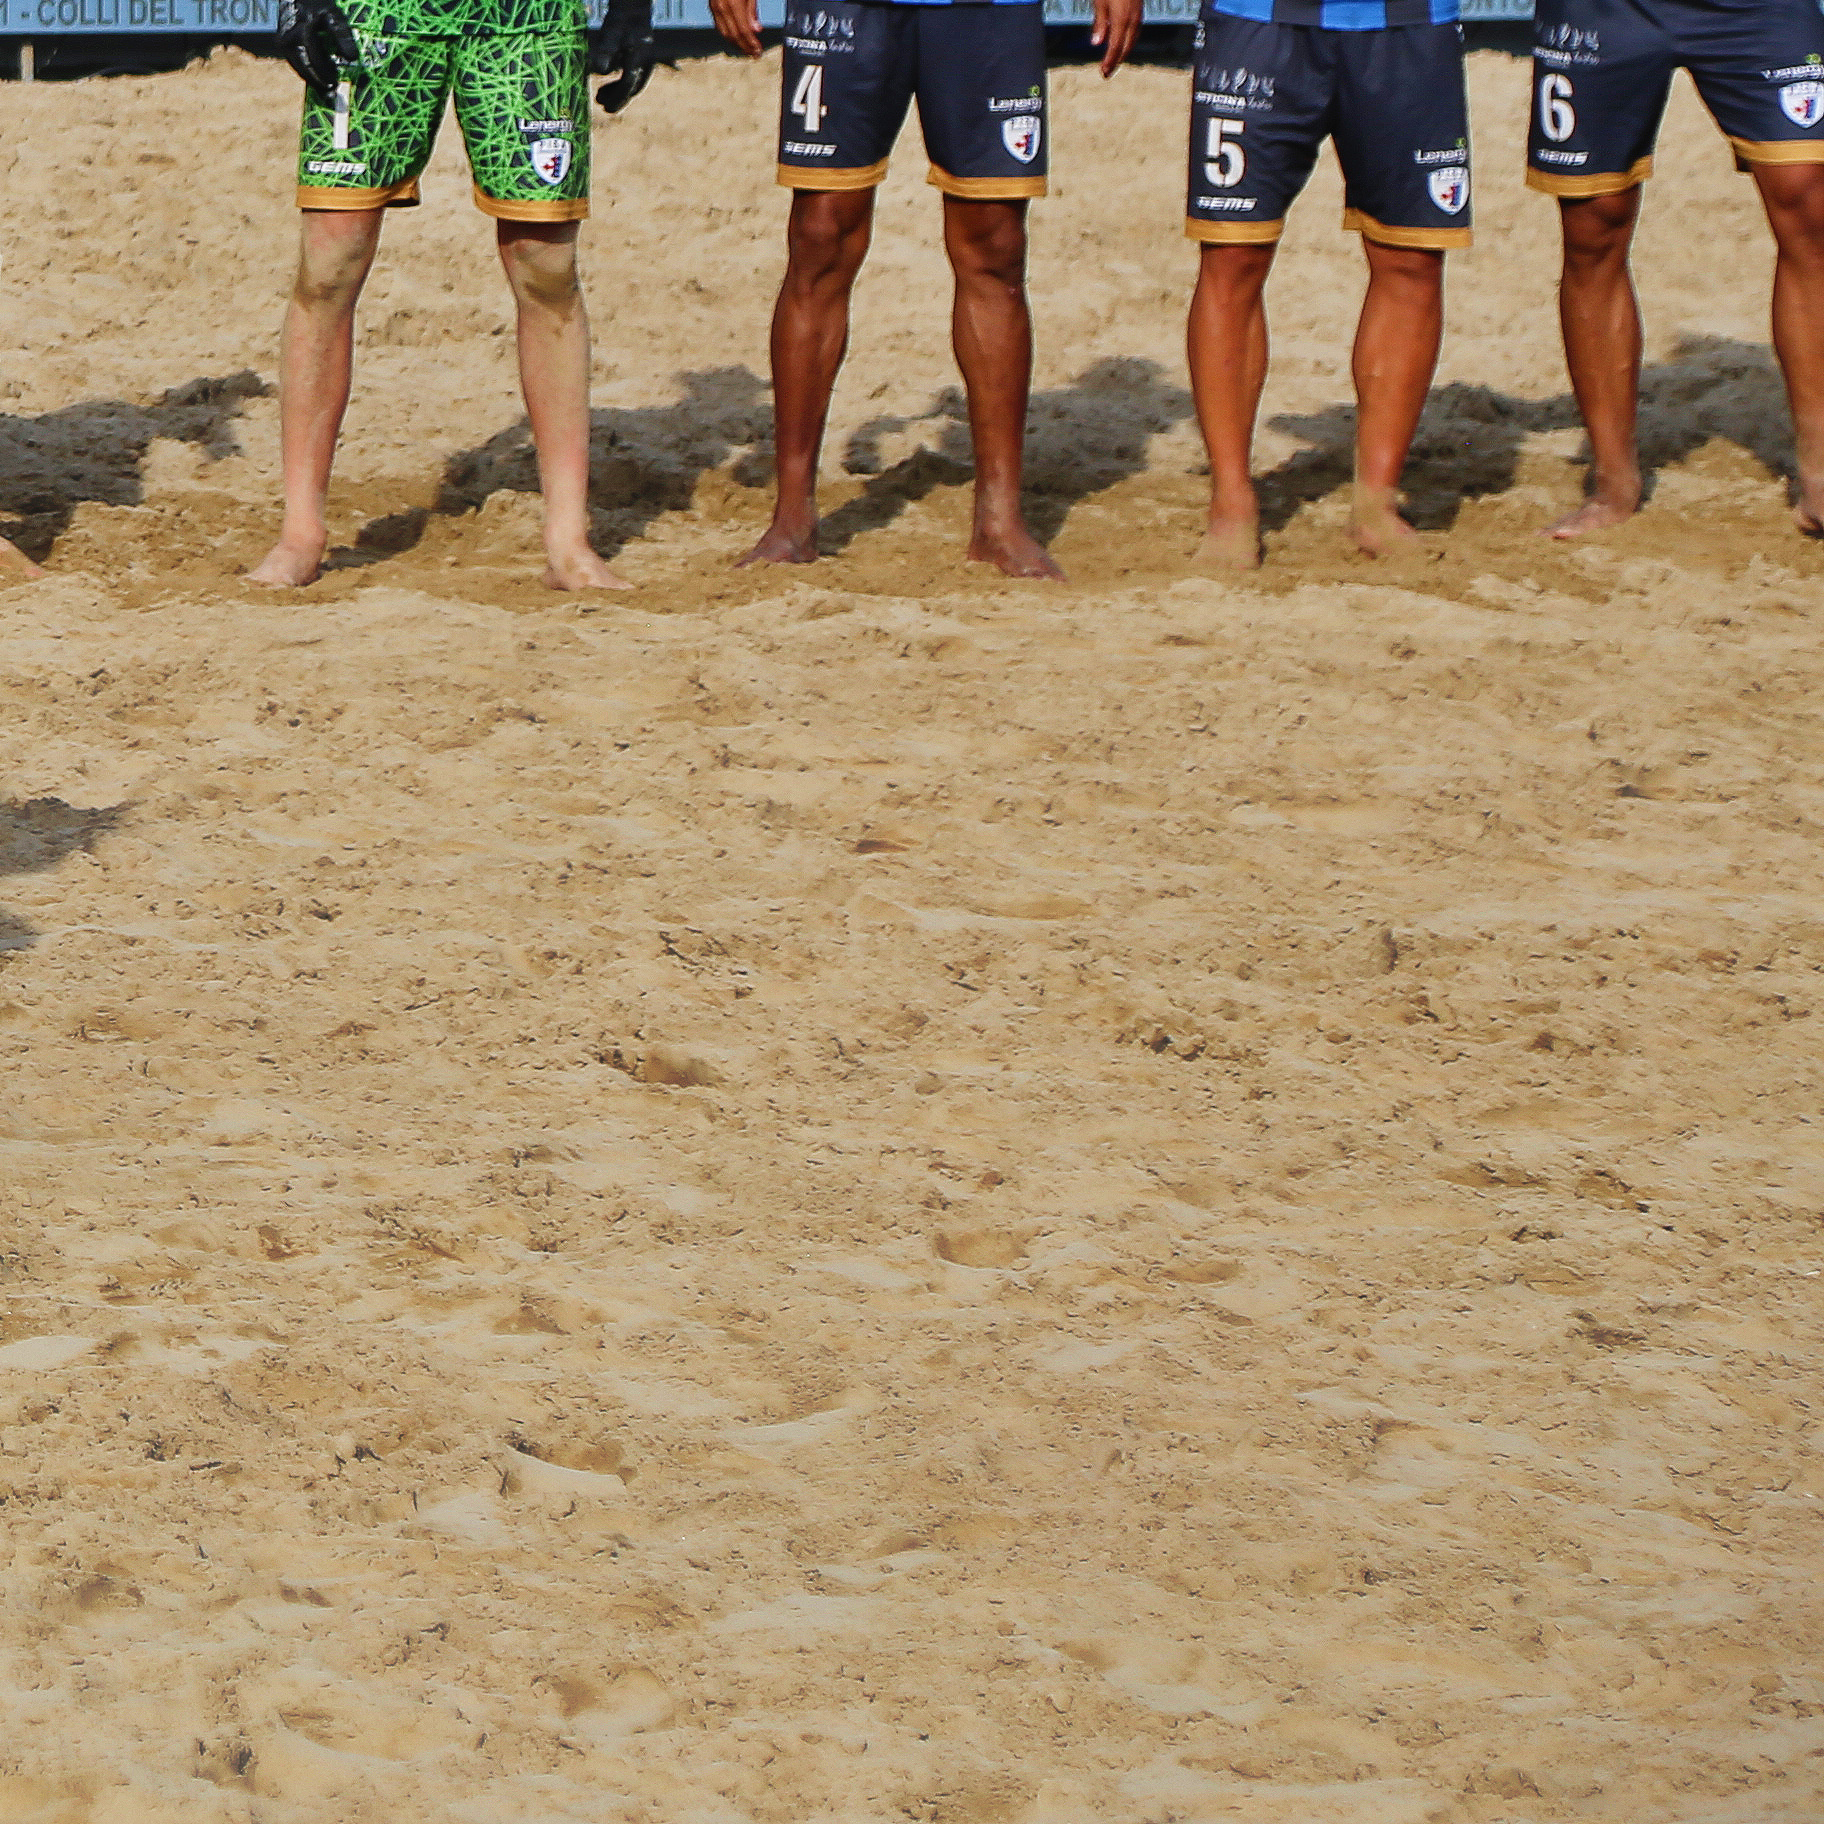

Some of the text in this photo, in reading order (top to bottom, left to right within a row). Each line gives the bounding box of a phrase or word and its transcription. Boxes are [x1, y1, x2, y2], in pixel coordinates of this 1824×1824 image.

[791, 64, 828, 133] 4
[1540, 74, 1576, 143] 6
[1204, 118, 1246, 188] 5
